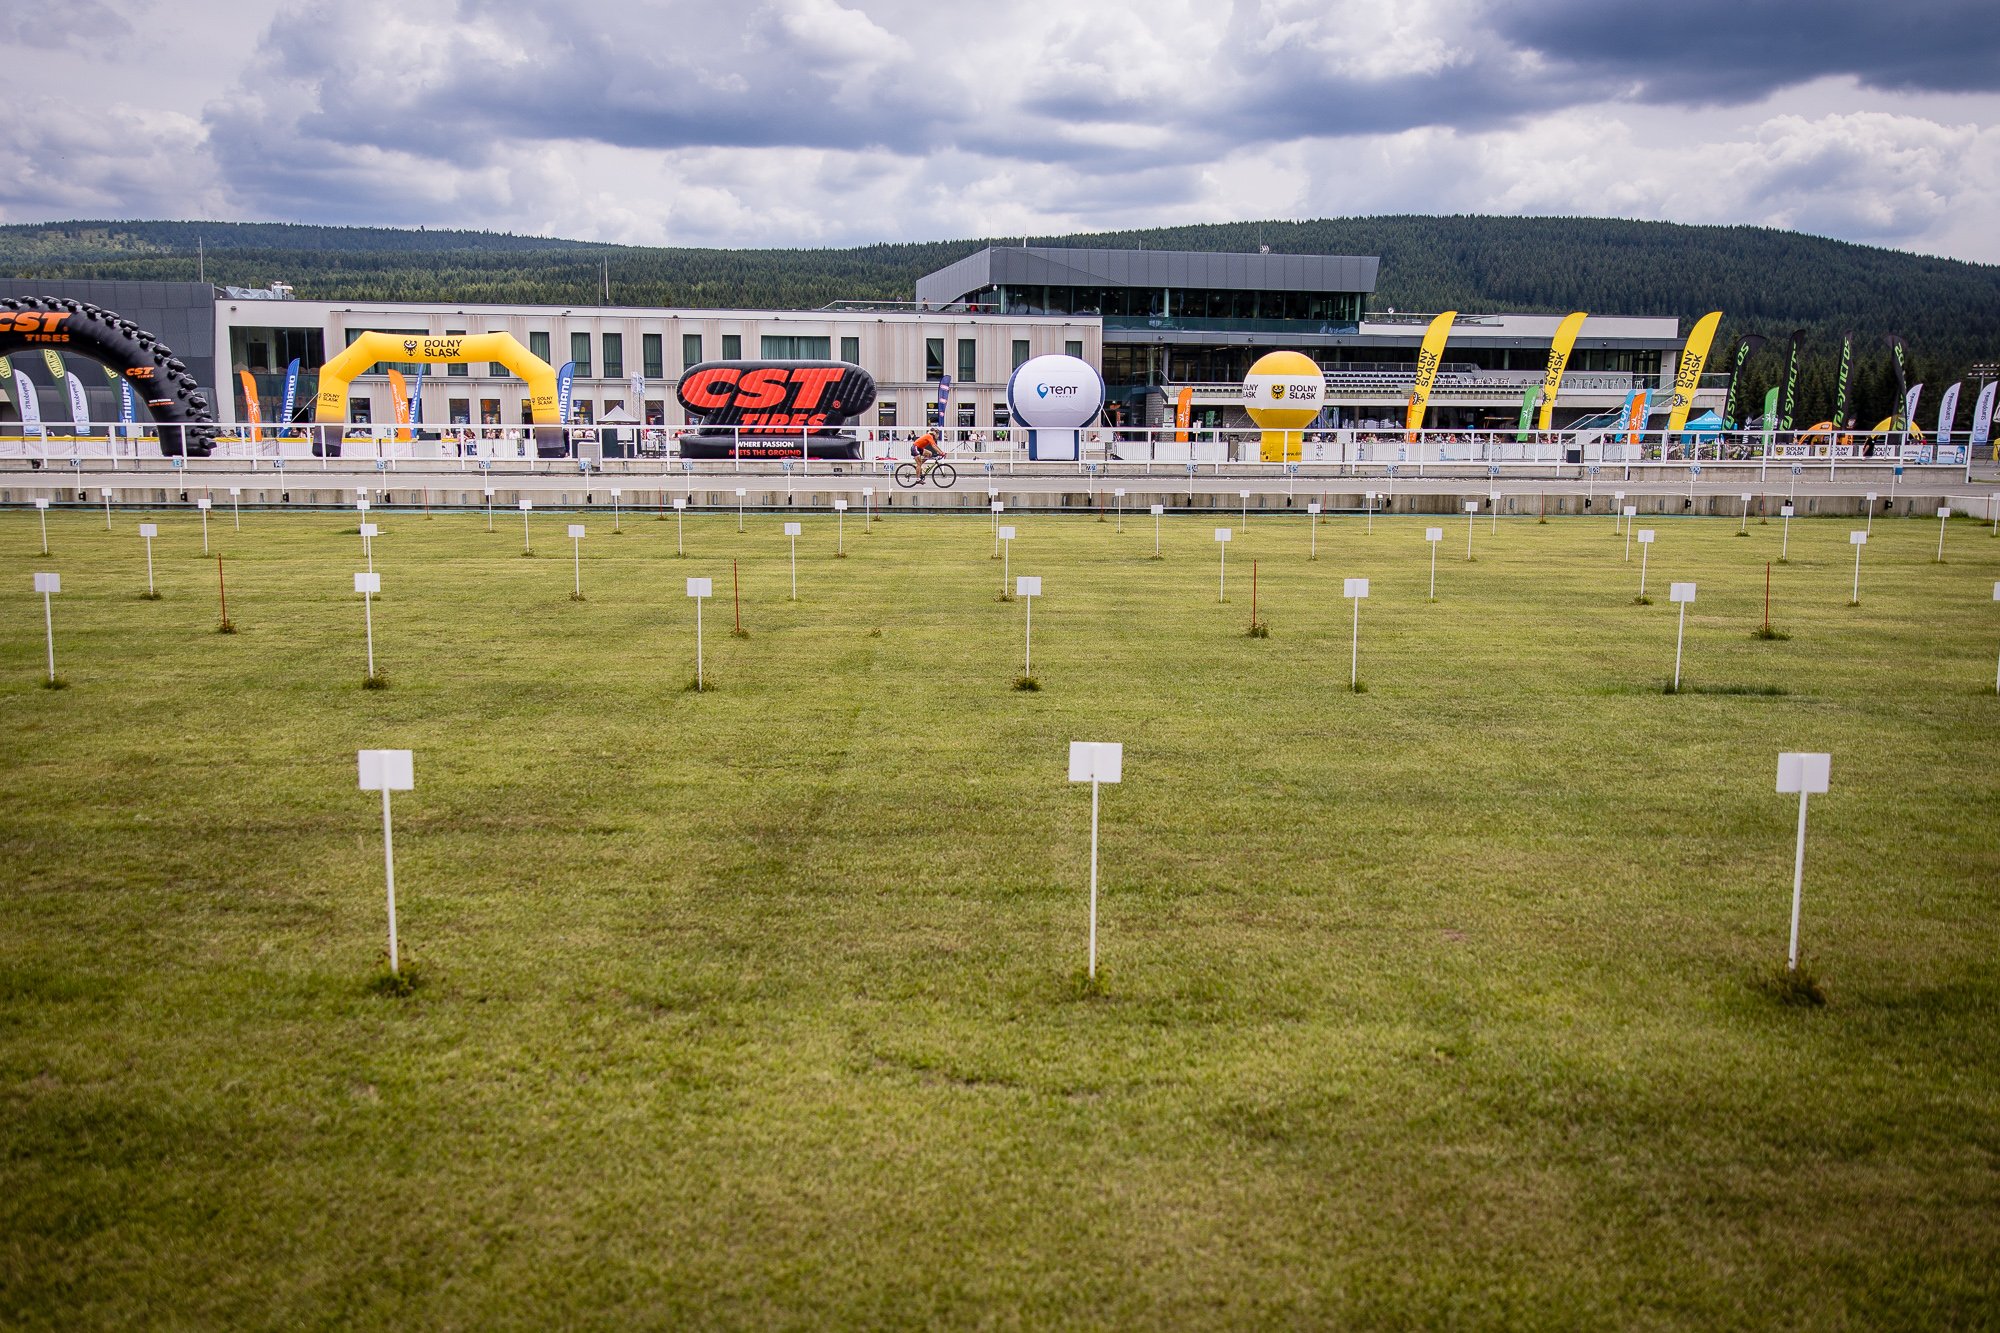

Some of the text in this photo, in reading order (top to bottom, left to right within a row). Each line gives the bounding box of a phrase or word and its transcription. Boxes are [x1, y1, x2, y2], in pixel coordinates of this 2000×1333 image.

[424, 340, 462, 348] DOLNY
[424, 348, 460, 358] ŚLĄSK
[126, 367, 154, 376] CST
[1677, 350, 1694, 388] DOLNY
[682, 368, 845, 408] CST
[1289, 392, 1316, 400] ŚLĄSK
[739, 414, 826, 434] TIRES
